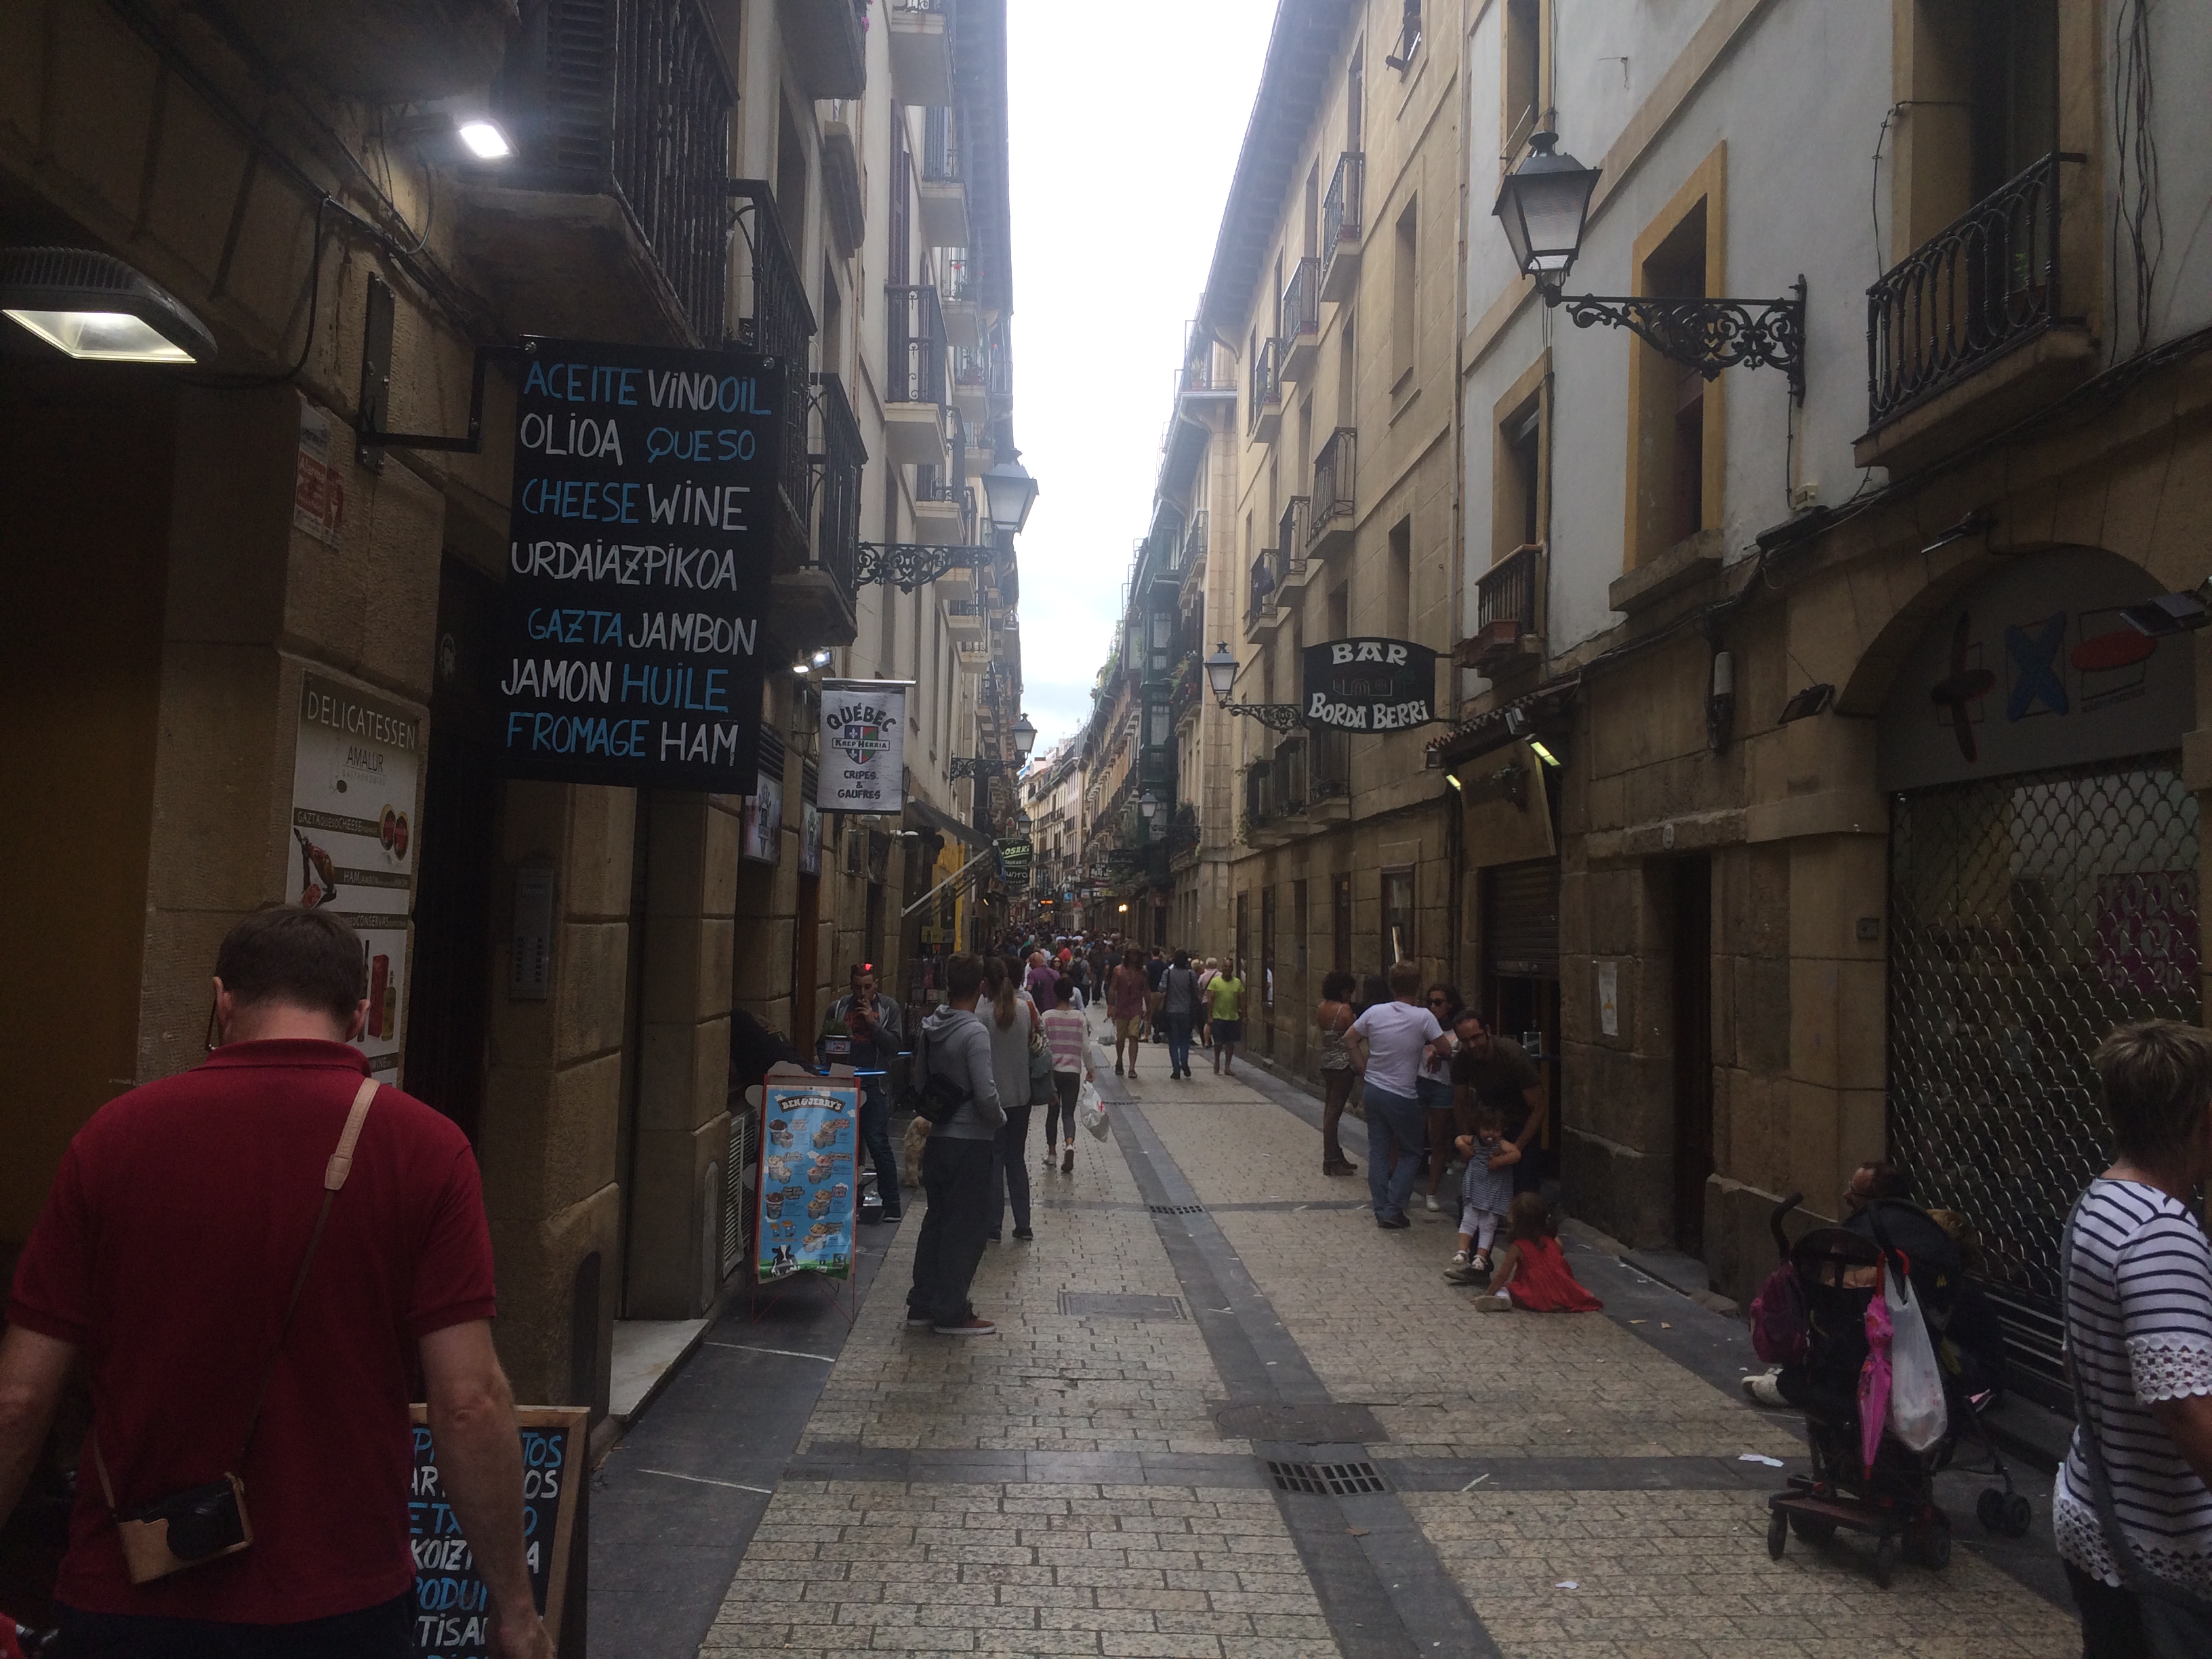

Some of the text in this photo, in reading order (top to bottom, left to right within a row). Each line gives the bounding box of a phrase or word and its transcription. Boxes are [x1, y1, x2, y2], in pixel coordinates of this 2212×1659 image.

[523, 361, 643, 406] ACEITE
[647, 427, 756, 464] QUESO
[522, 478, 641, 524] CHEESE
[528, 608, 757, 656] GAZTA JAMBON
[1331, 642, 1408, 666] BAR
[501, 658, 613, 703] JAMON
[307, 690, 415, 750] DELICATESSEN
[826, 703, 897, 733] QUÉBEC
[1308, 693, 1367, 729] BORDA
[506, 712, 739, 766] FROMAGE HAM
[346, 746, 384, 773] AMALUR
[838, 790, 881, 800] GAUFRES
[856, 781, 863, 789] &
[297, 811, 321, 825] GAZTA
[344, 870, 360, 883] HAM
